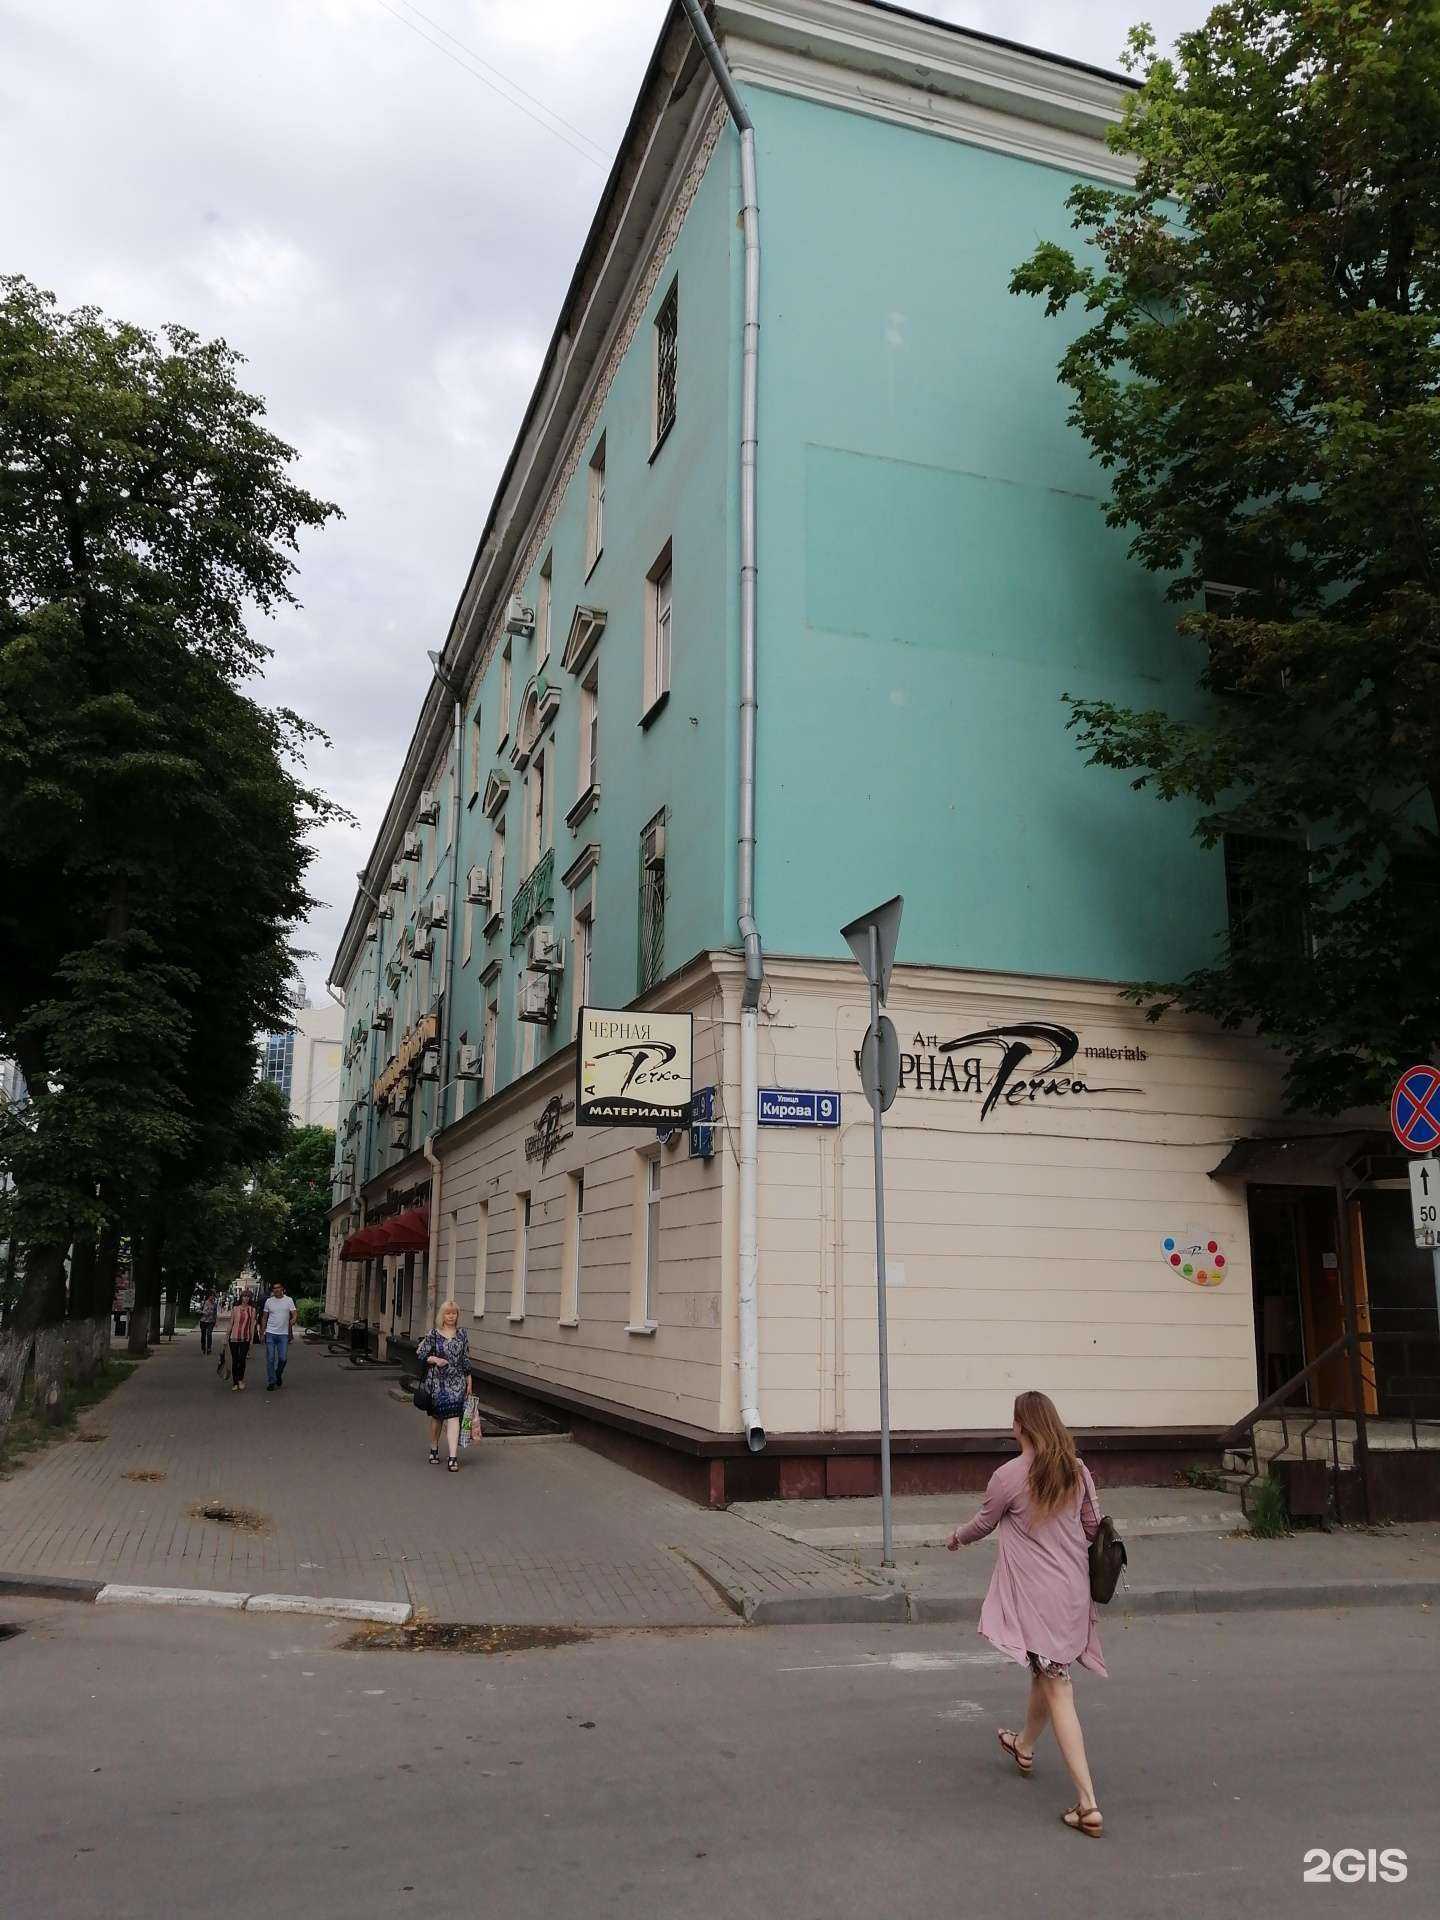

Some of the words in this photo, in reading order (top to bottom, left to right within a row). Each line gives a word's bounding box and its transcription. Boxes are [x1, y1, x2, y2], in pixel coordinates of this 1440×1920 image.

[589, 1021, 651, 1040] ЧЕРНАЯ
[912, 1031, 940, 1048] Art
[1084, 1045, 1147, 1061] materials
[585, 1060, 596, 1096] АТ
[854, 1050, 983, 1093] РНАЯ
[589, 1106, 683, 1118] МАТЕРИАЛЫ
[763, 1102, 812, 1118] Кирова
[820, 1099, 833, 1117] 9
[1419, 1205, 1437, 1222] 50
